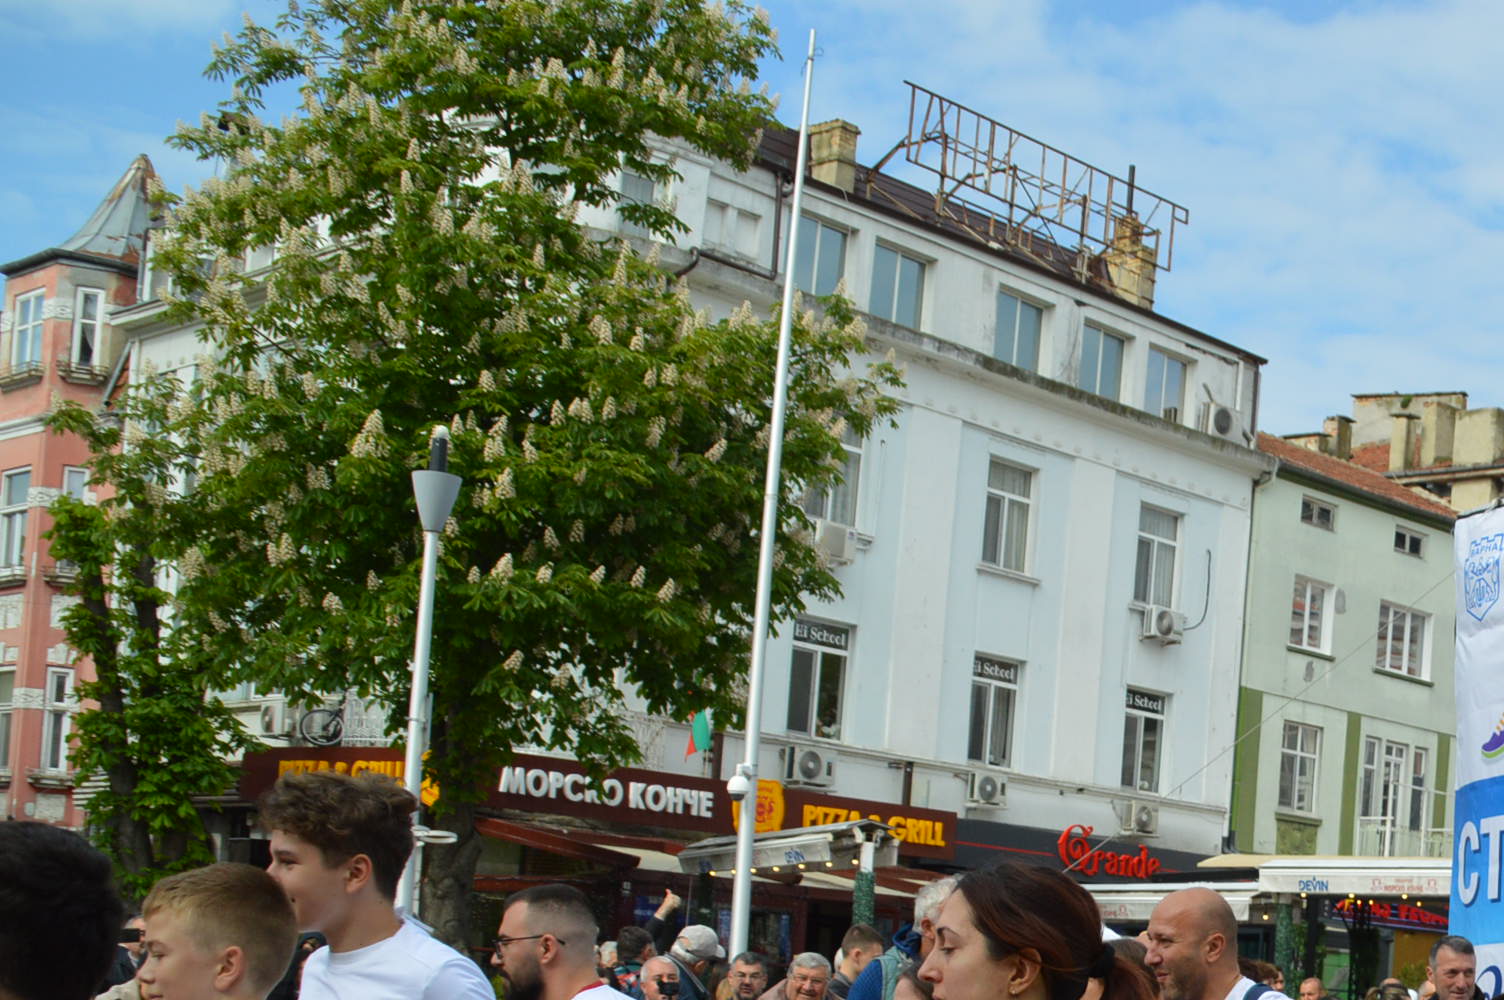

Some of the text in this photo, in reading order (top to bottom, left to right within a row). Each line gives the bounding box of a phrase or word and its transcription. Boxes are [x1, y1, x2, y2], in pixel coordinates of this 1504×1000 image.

[810, 626, 846, 647] School
[628, 781, 714, 818] КОНЧЕ
[887, 816, 946, 847] GRILL
[1057, 824, 1161, 879] Grande
[1298, 879, 1329, 892] DEVIN
